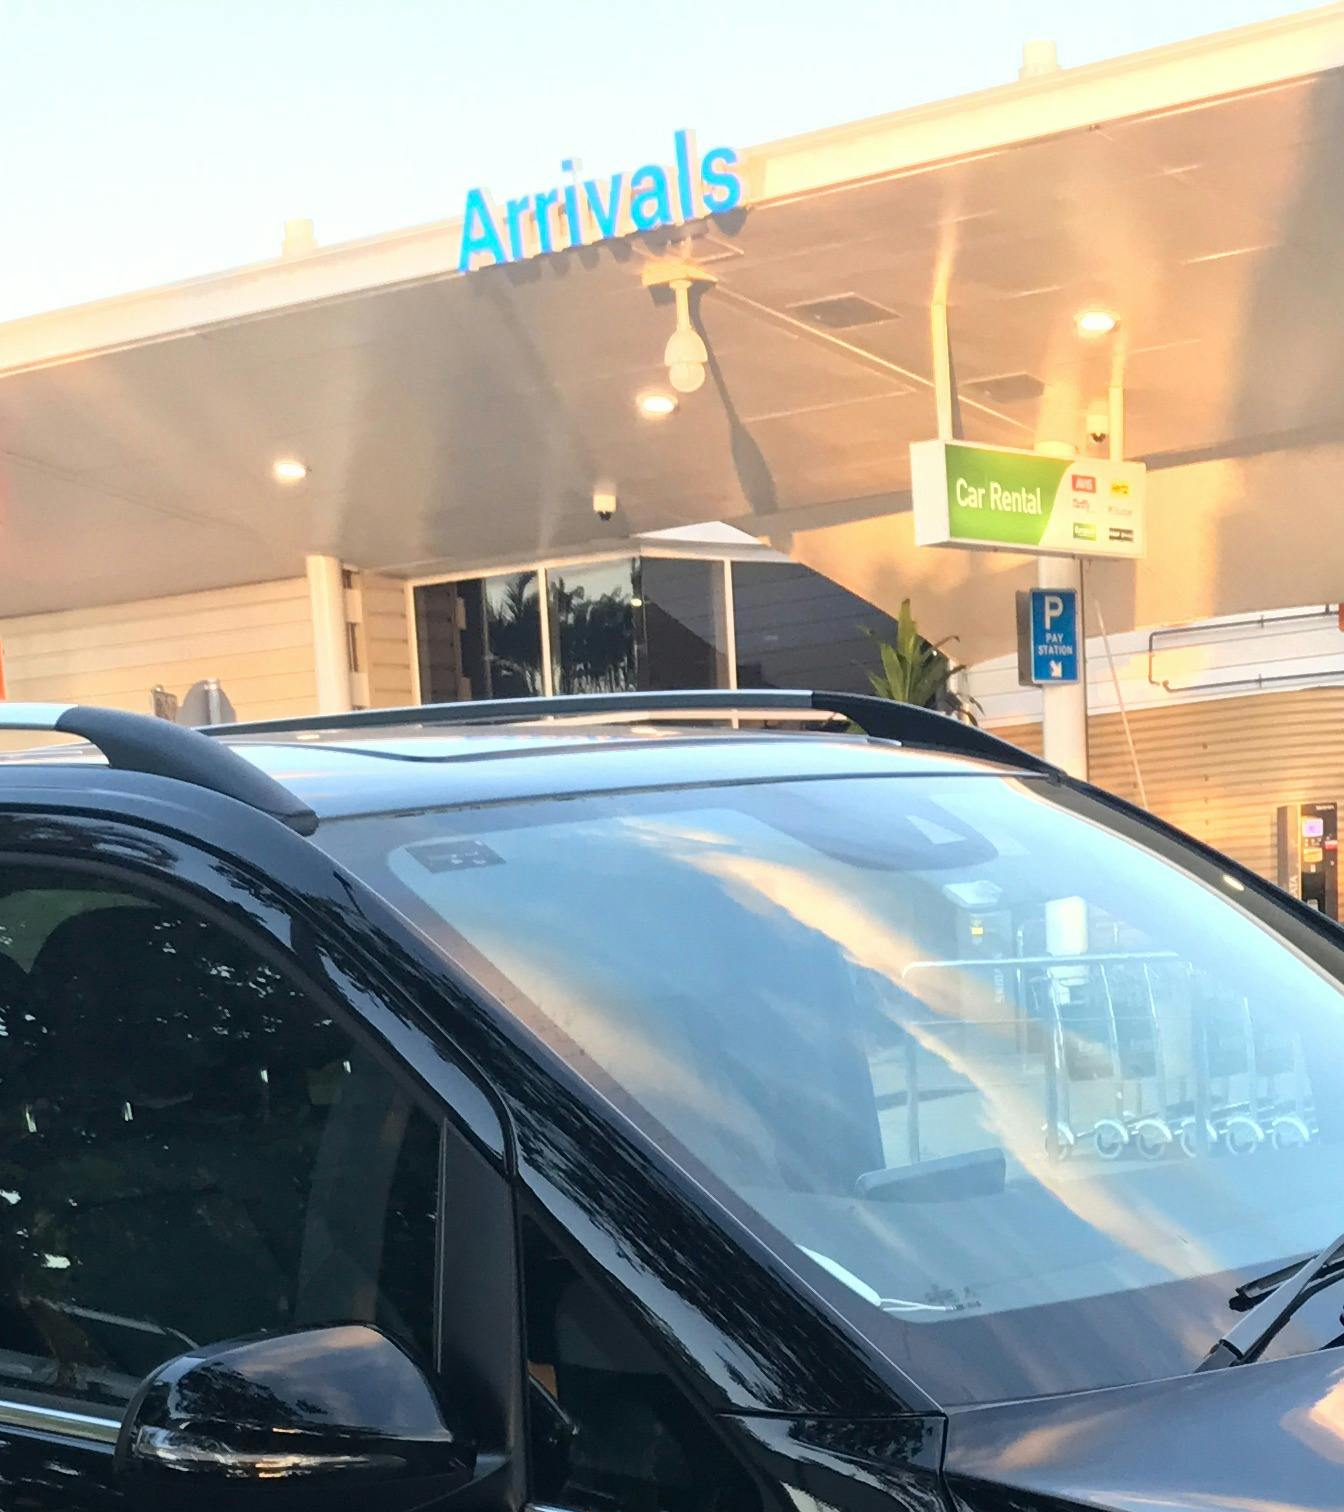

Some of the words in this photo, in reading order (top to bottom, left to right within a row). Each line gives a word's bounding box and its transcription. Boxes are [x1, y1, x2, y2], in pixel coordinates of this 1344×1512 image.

[457, 129, 742, 273] Arrivals
[955, 478, 984, 509] Car
[989, 481, 1042, 515] Rental
[1044, 595, 1064, 630] P
[1038, 644, 1073, 656] STATION
[1045, 633, 1064, 643] PAY
